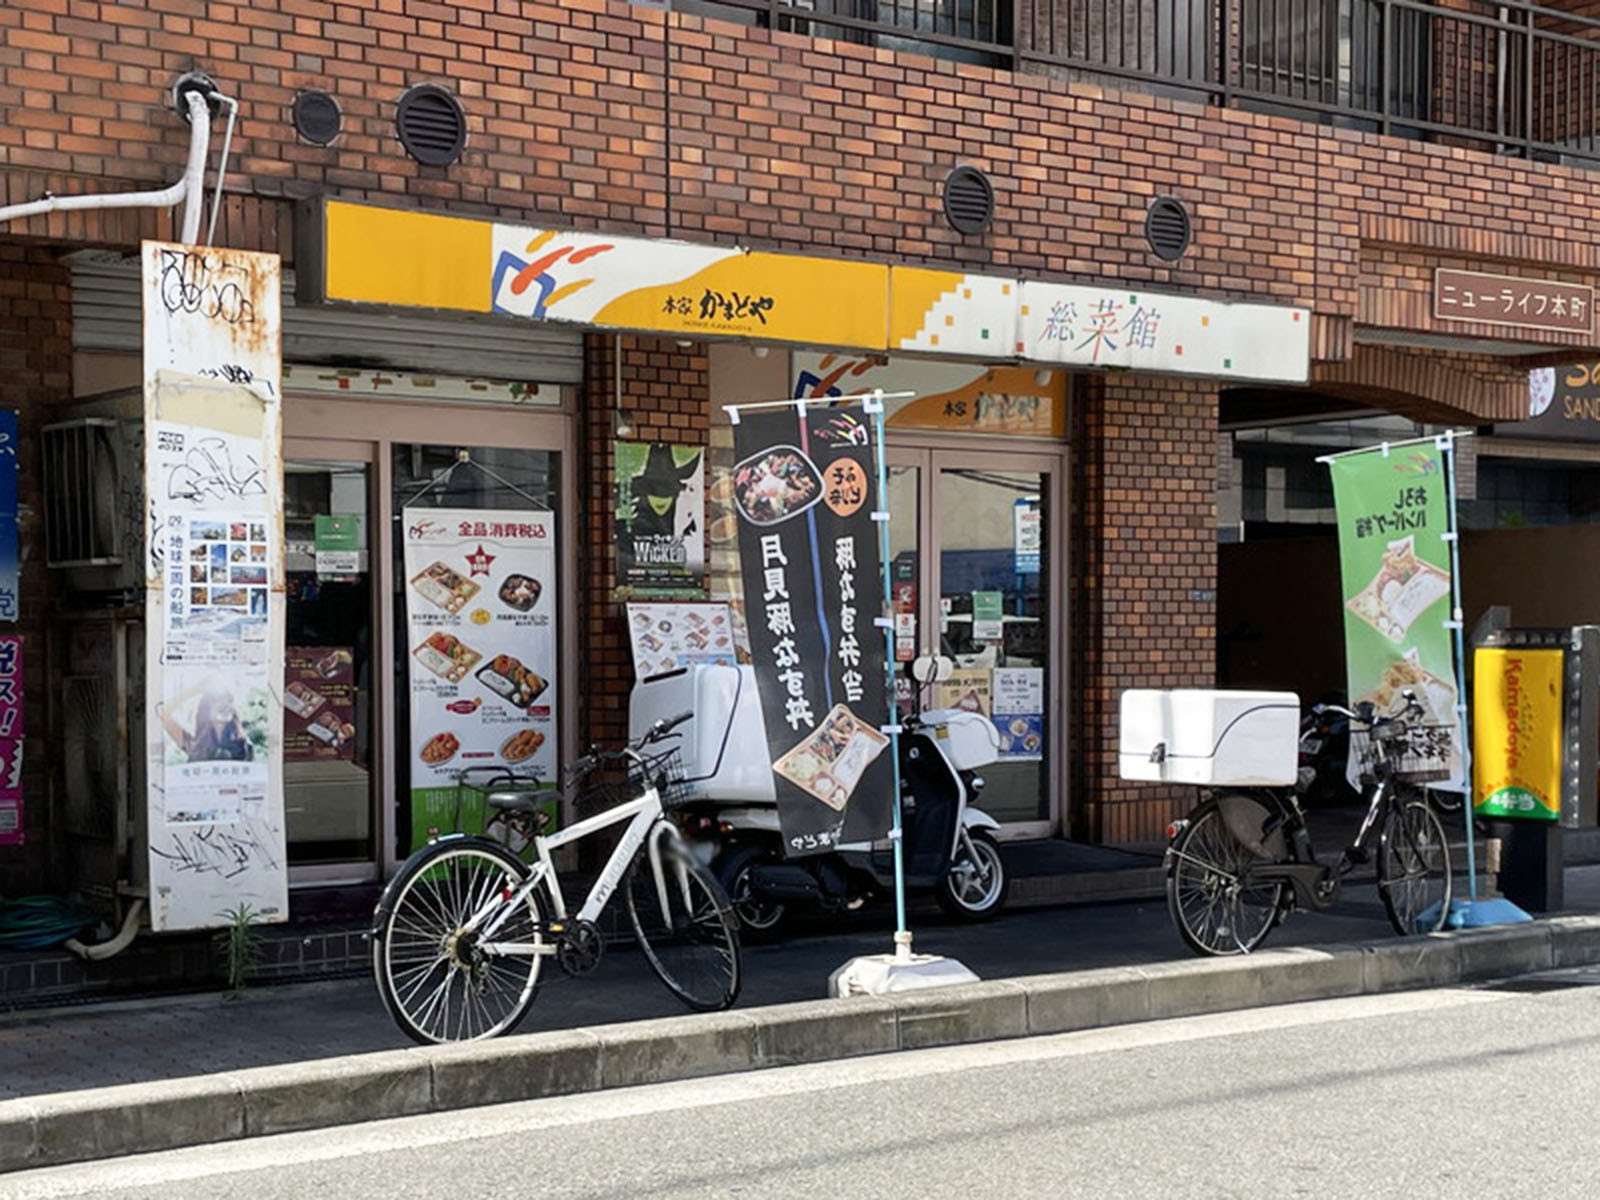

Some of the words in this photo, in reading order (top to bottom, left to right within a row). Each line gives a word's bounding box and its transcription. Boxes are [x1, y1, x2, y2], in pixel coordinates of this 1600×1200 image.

[662, 295, 693, 315] 本家
[699, 288, 775, 325] かまどや
[1038, 299, 1161, 363] 総菜館
[1441, 285, 1587, 323] ニューライフ本町
[170, 536, 184, 630] 地球一周の船旅
[1505, 658, 1523, 770] Kamadoya
